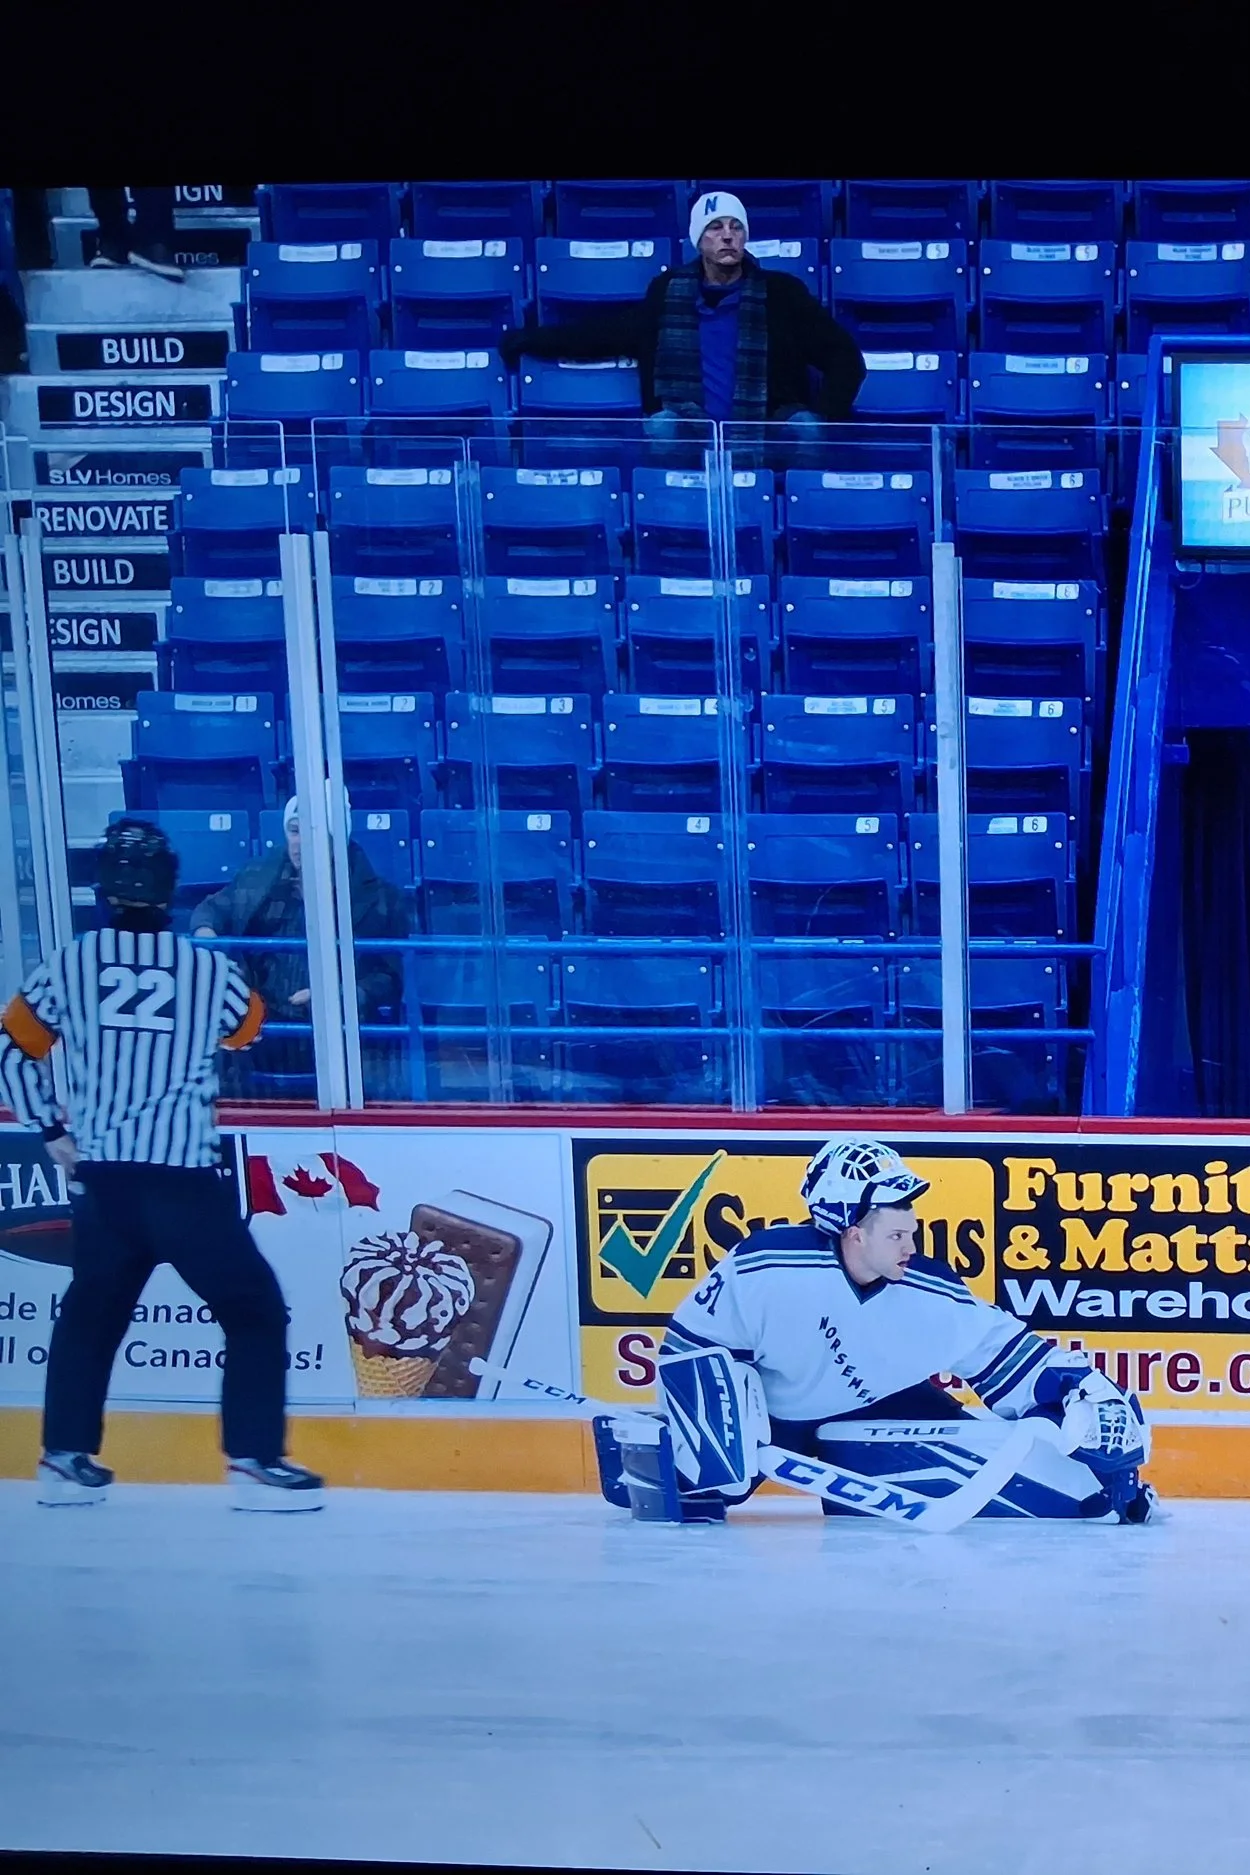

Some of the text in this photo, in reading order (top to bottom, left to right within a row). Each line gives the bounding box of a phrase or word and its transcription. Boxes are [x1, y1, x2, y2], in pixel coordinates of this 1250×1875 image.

[705, 195, 719, 216] N
[102, 339, 184, 363] BUILD
[74, 391, 176, 418] DESIGN
[36, 506, 169, 533] RENOVATE
[53, 559, 134, 585] BUILD
[100, 966, 176, 1031] 22
[1002, 1224, 1052, 1271] &
[694, 1271, 725, 1318] 31
[818, 1316, 878, 1404] NORSEMEN
[523, 1378, 588, 1405] CCM
[863, 1426, 961, 1438] TRUE
[774, 1454, 932, 1522] CCM
